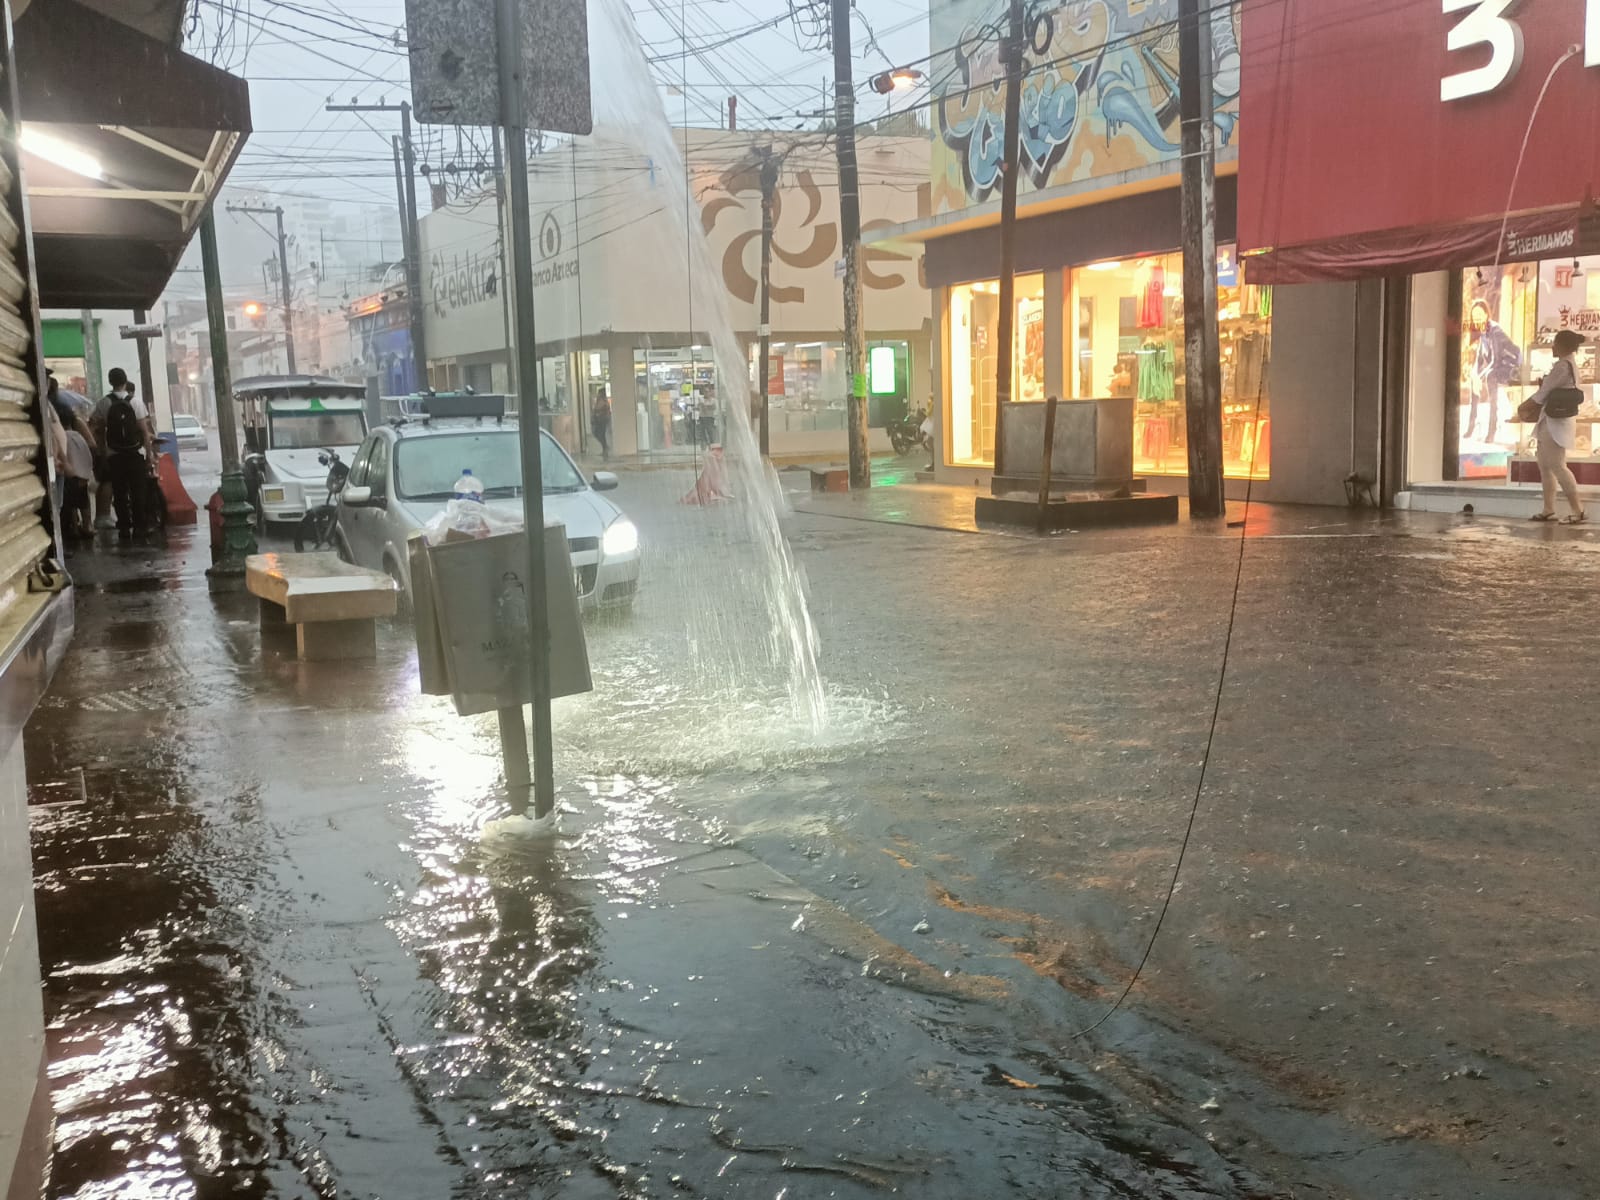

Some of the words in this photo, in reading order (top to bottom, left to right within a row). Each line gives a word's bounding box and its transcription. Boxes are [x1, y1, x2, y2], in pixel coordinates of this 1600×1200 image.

[1440, 0, 1523, 102] 3
[1516, 229, 1575, 255] HERMANOS
[448, 249, 498, 308] elektra
[1560, 314, 1569, 327] 3
